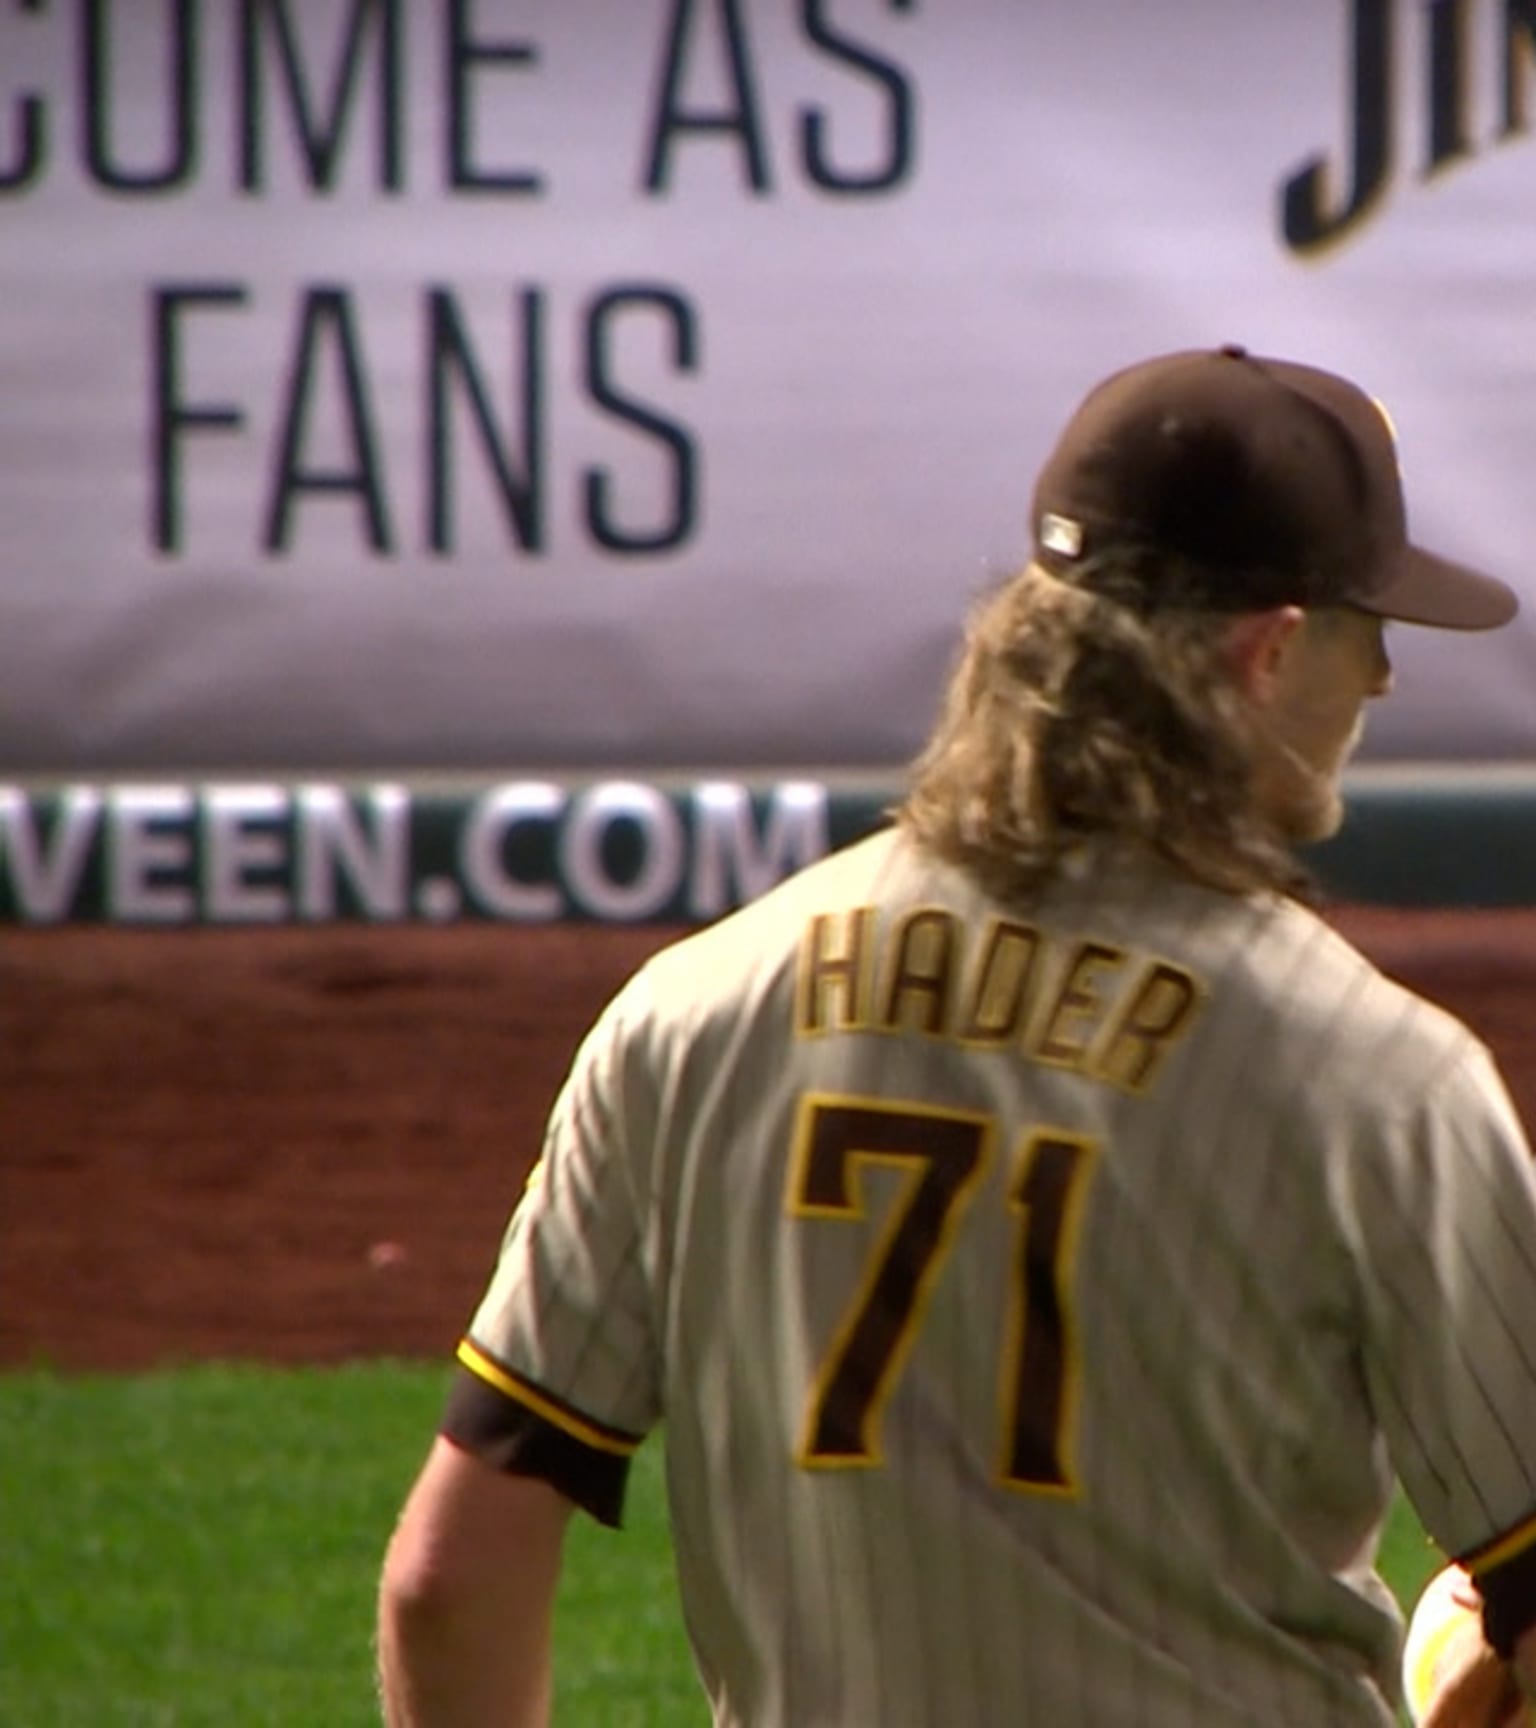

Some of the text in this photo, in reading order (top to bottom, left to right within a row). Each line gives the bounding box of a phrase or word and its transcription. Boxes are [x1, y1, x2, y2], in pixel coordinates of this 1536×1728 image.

[640, 0, 918, 195] AS
[149, 284, 700, 555] FANS
[798, 905, 1208, 1093] HADER
[789, 1093, 1097, 1497] 71
